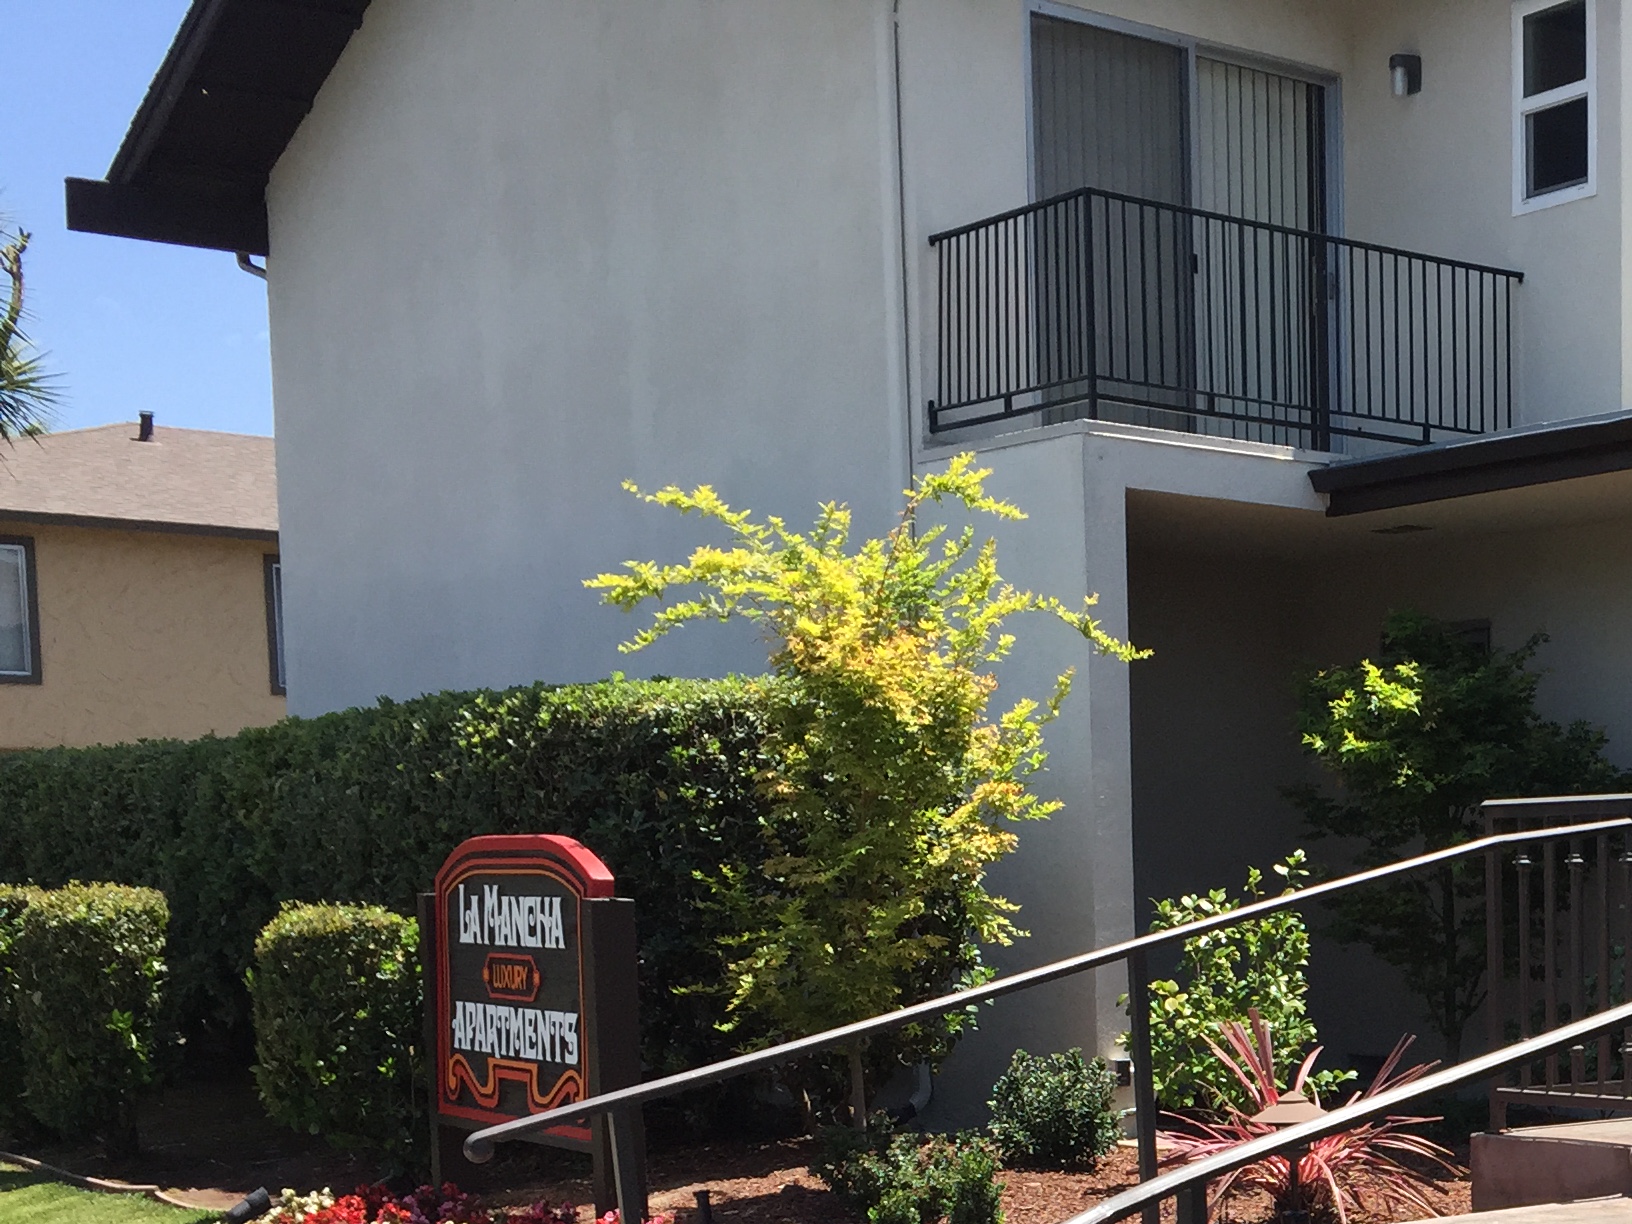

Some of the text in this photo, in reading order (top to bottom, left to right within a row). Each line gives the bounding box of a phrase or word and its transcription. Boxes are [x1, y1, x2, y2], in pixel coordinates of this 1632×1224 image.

[483, 884, 566, 949] MANCHA
[492, 964, 529, 990] LUXURY
[452, 1001, 579, 1065] APARTMENTS
